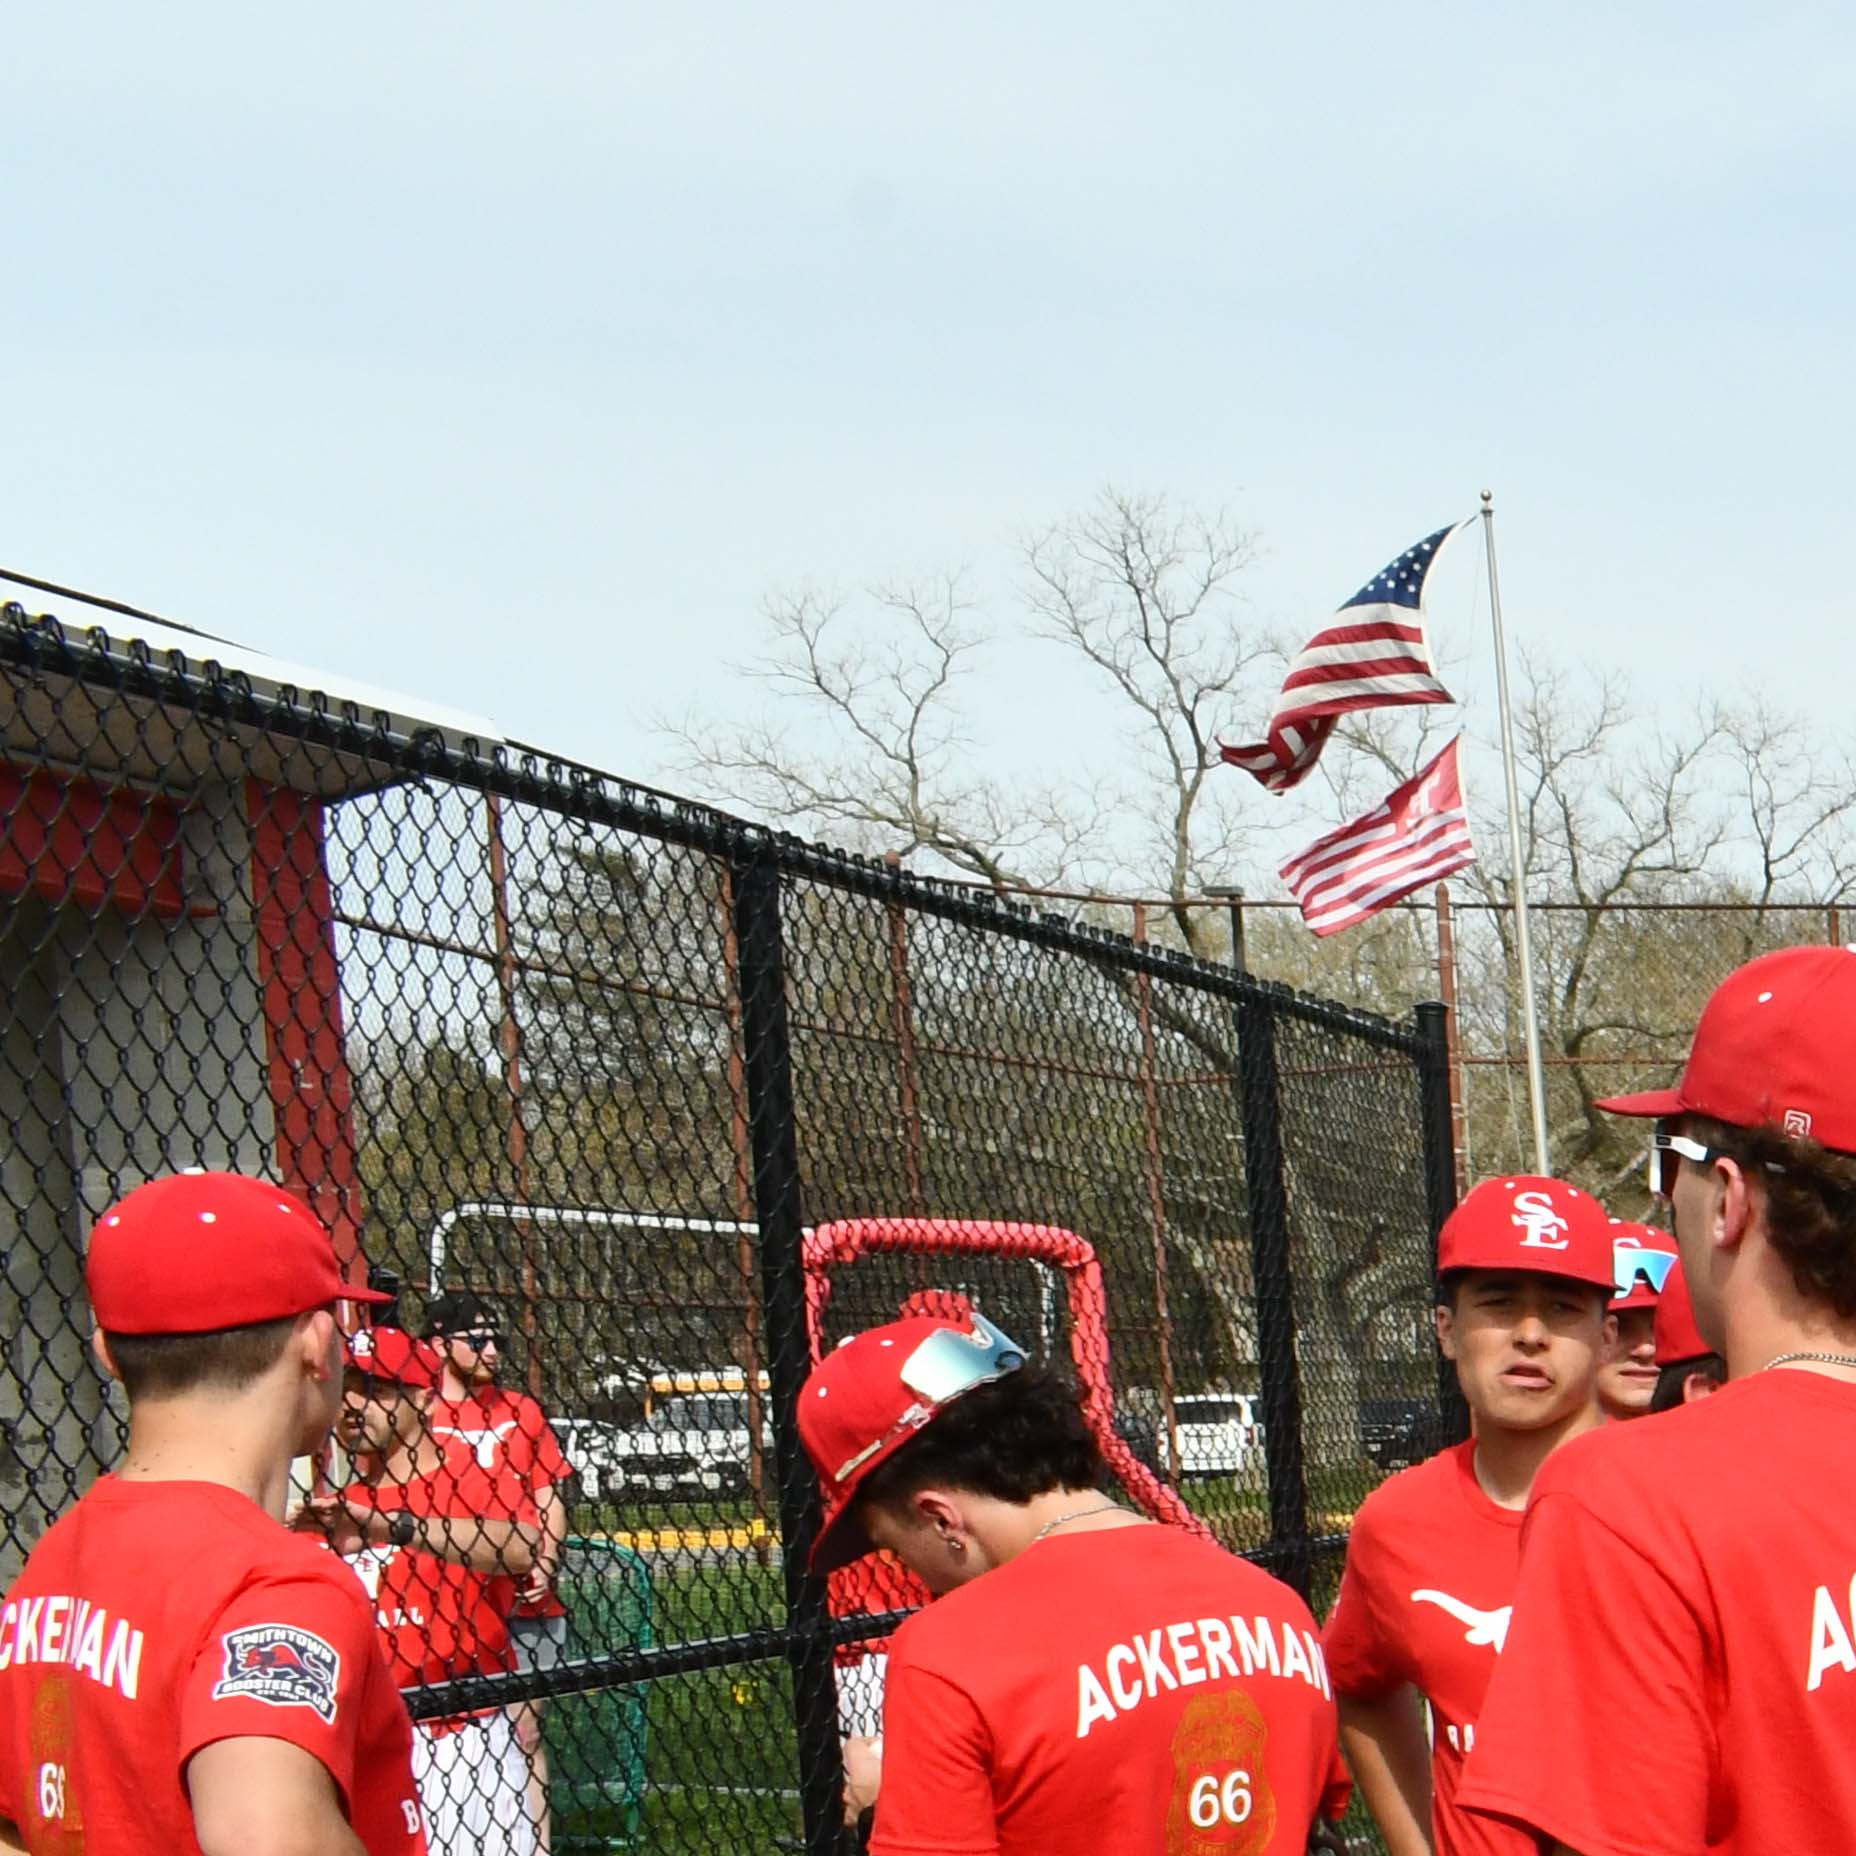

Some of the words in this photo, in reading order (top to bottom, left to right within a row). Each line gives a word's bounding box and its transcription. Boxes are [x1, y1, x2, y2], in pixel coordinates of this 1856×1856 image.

[1511, 1191, 1569, 1250] SE
[232, 1629, 332, 1663] SMITHTOWN
[294, 1684, 329, 1712] CLUB
[1076, 1615, 1332, 1739] ACKERMAN
[1189, 1770, 1252, 1828] 66
